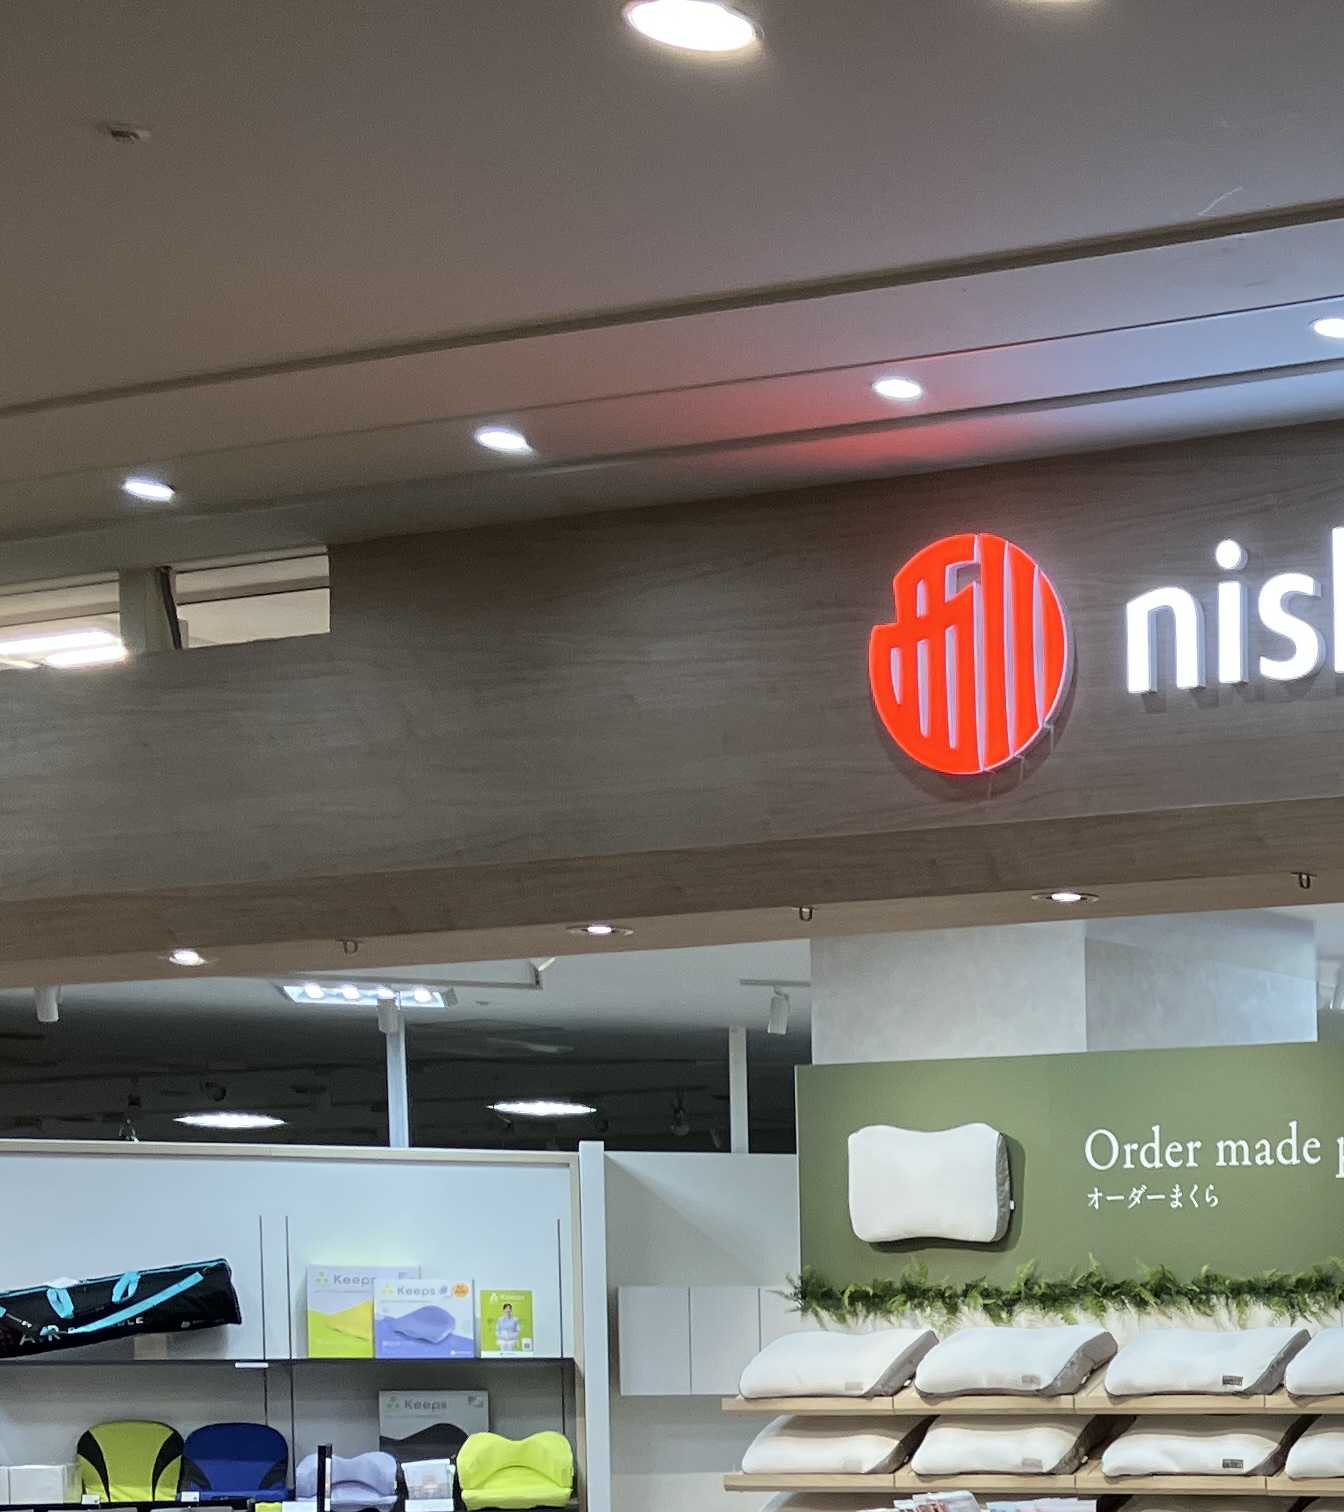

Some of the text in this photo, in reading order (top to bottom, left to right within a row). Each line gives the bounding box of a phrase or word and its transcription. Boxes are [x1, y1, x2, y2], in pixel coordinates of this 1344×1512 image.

[1084, 1124, 1203, 1171] Order
[1215, 1120, 1322, 1167] made
[1086, 1183, 1220, 1210] オーダーまくら
[397, 1285, 436, 1297] Keeps
[404, 1399, 447, 1412] Keeps
